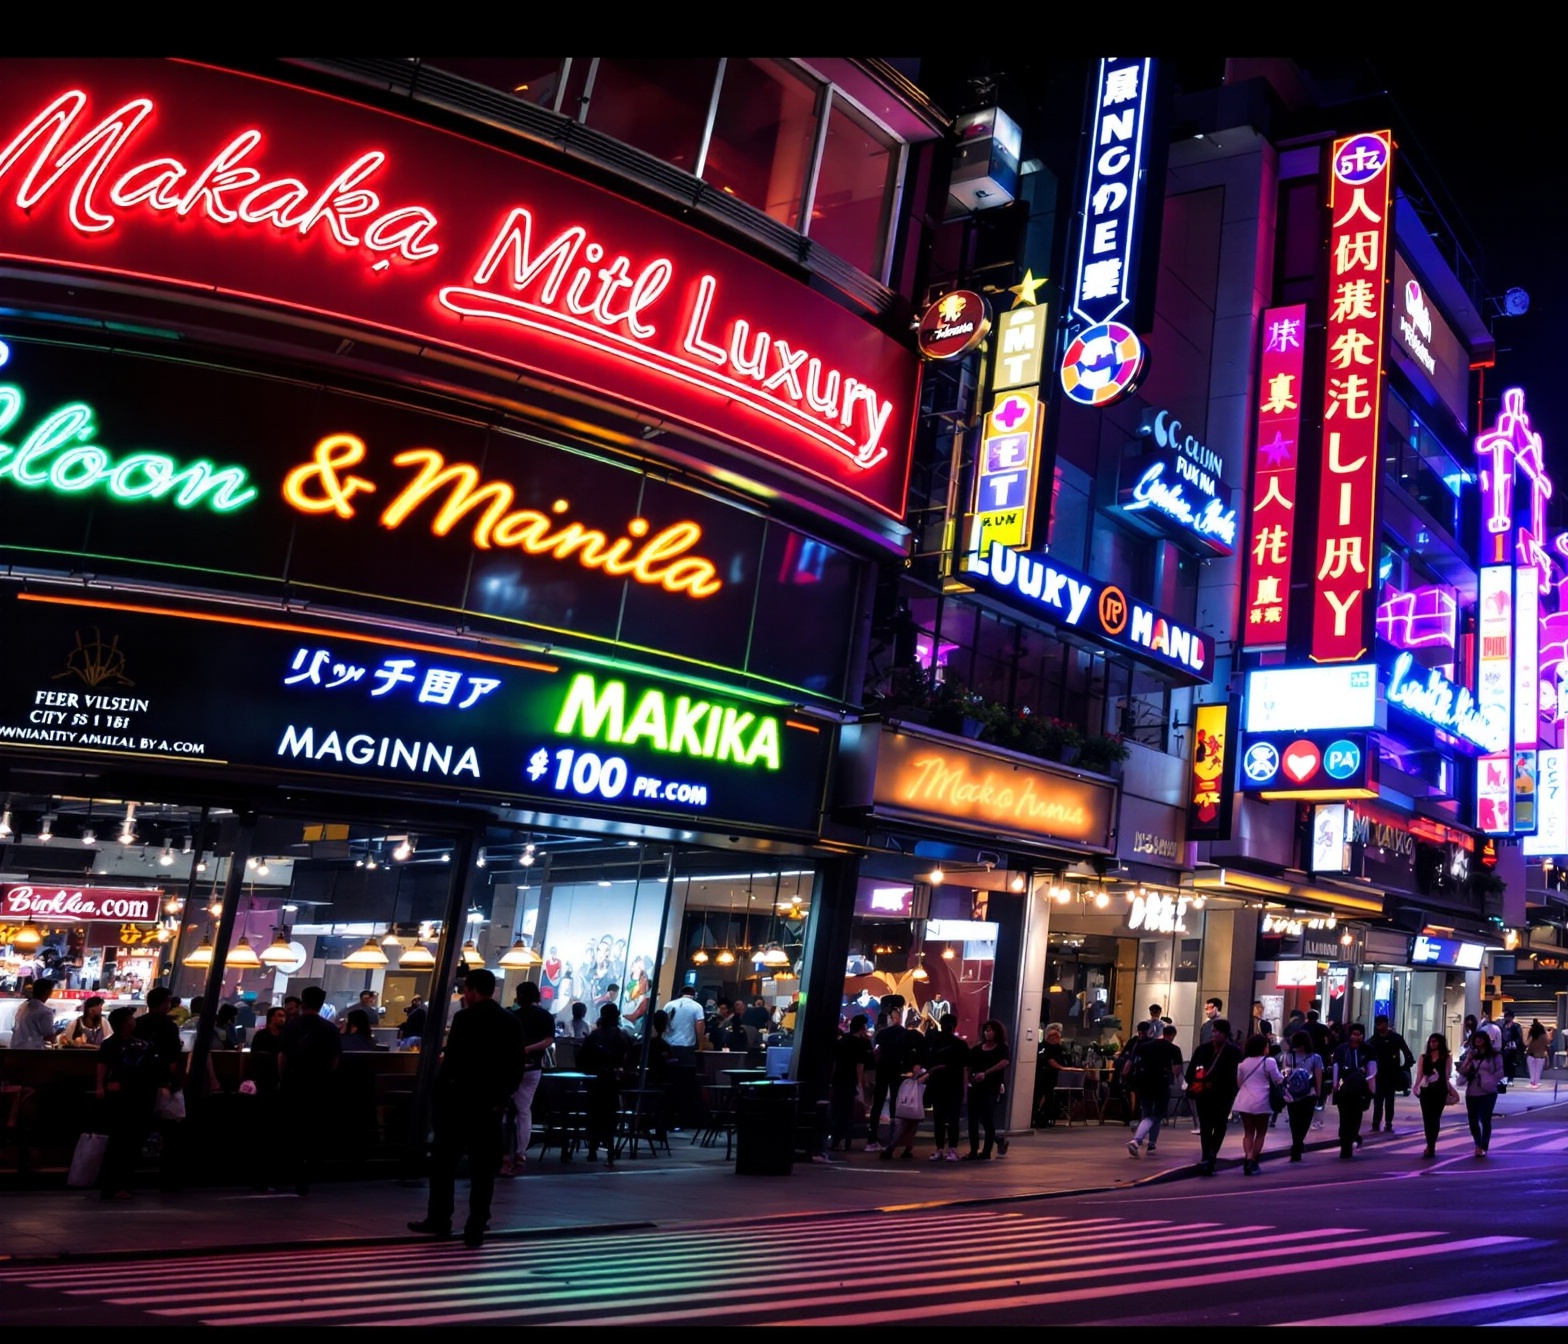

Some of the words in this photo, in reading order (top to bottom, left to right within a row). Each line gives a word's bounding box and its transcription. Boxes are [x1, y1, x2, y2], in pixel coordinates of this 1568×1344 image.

[683, 275, 893, 468] Luxury
[283, 433, 377, 519] &
[29, 709, 67, 725] CITY
[35, 690, 79, 709] FEER
[554, 673, 780, 771] MAKIKA
[277, 724, 481, 779] MAGINNA
